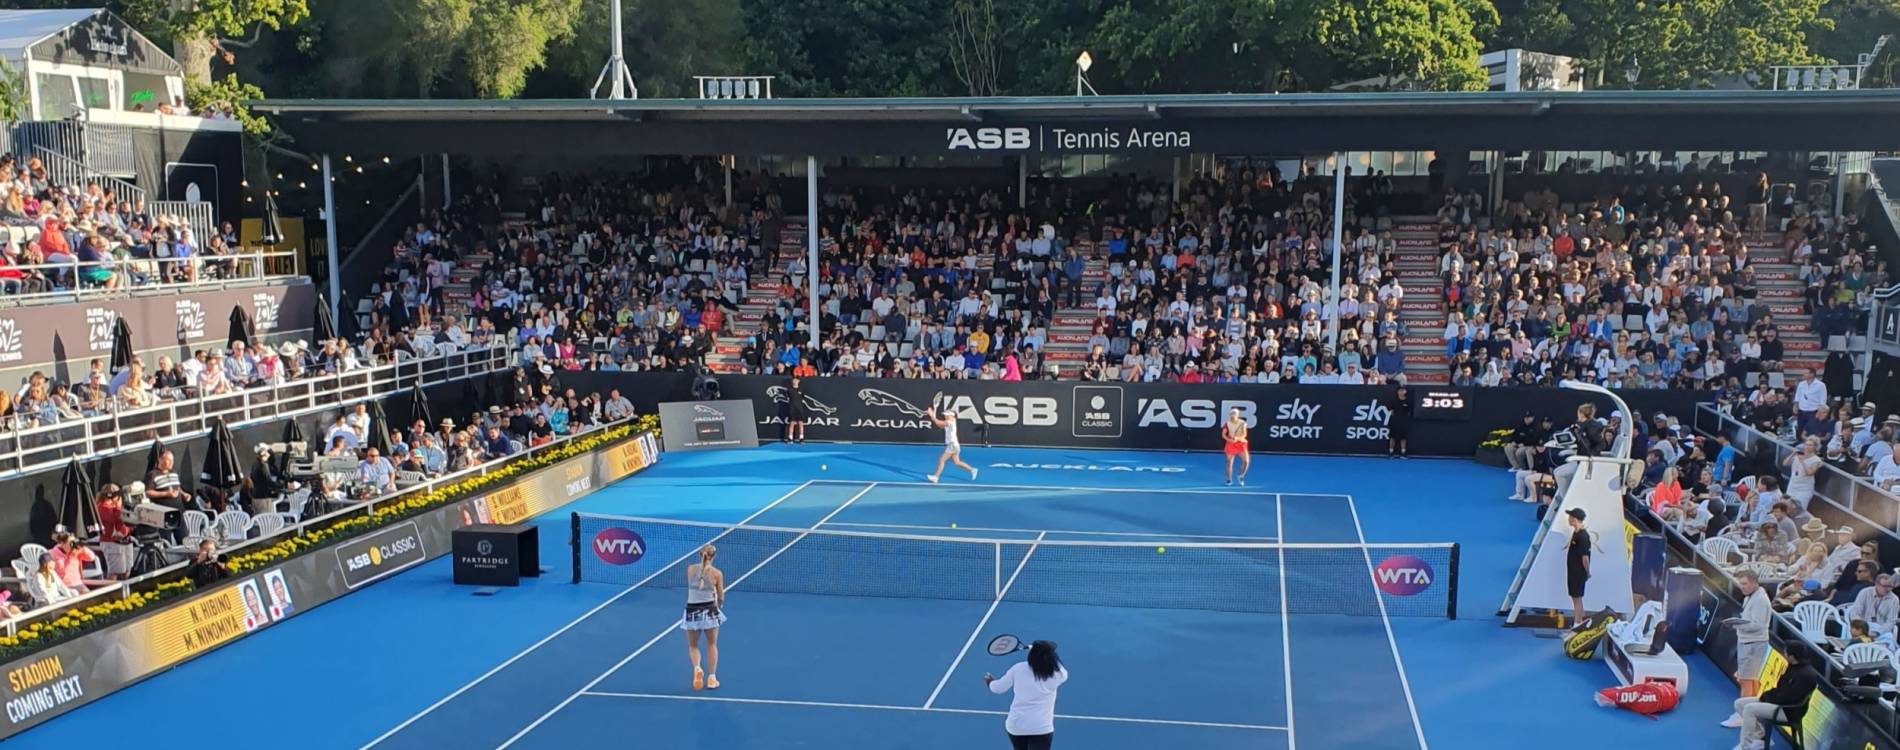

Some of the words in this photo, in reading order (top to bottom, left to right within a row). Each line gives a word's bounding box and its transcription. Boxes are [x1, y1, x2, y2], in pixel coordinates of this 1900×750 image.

[947, 127, 1031, 150] ASB
[1052, 128, 1120, 149] Tennis
[1127, 127, 1191, 149] Arena
[178, 302, 206, 331] LOVE
[255, 296, 279, 322] LOVE
[90, 310, 116, 342] LOV
[943, 395, 1059, 426] ASB
[1085, 412, 1111, 420] ASB
[1137, 398, 1258, 429] ASB
[1275, 397, 1322, 425] sky
[1352, 398, 1393, 426] sky
[1421, 397, 1464, 409] 3:03
[759, 415, 840, 426] JAAR
[850, 418, 932, 429] JAGUAR
[1081, 420, 1113, 428] CLASSIC
[1269, 425, 1323, 439] SPORT
[1346, 426, 1391, 440] SPOR
[988, 462, 1187, 473] AUCKLAND
[346, 552, 372, 572] ASB
[380, 535, 416, 560] CLASSIC
[595, 538, 643, 555] WTA
[1377, 567, 1431, 585] WTA
[189, 605, 202, 624] N.
[200, 593, 232, 619] HIBINO
[183, 632, 198, 651] M.
[195, 614, 240, 647] NINOMIYA
[8, 655, 64, 693] STADIUM
[6, 686, 54, 724] COMING
[51, 675, 83, 705] NEXT
